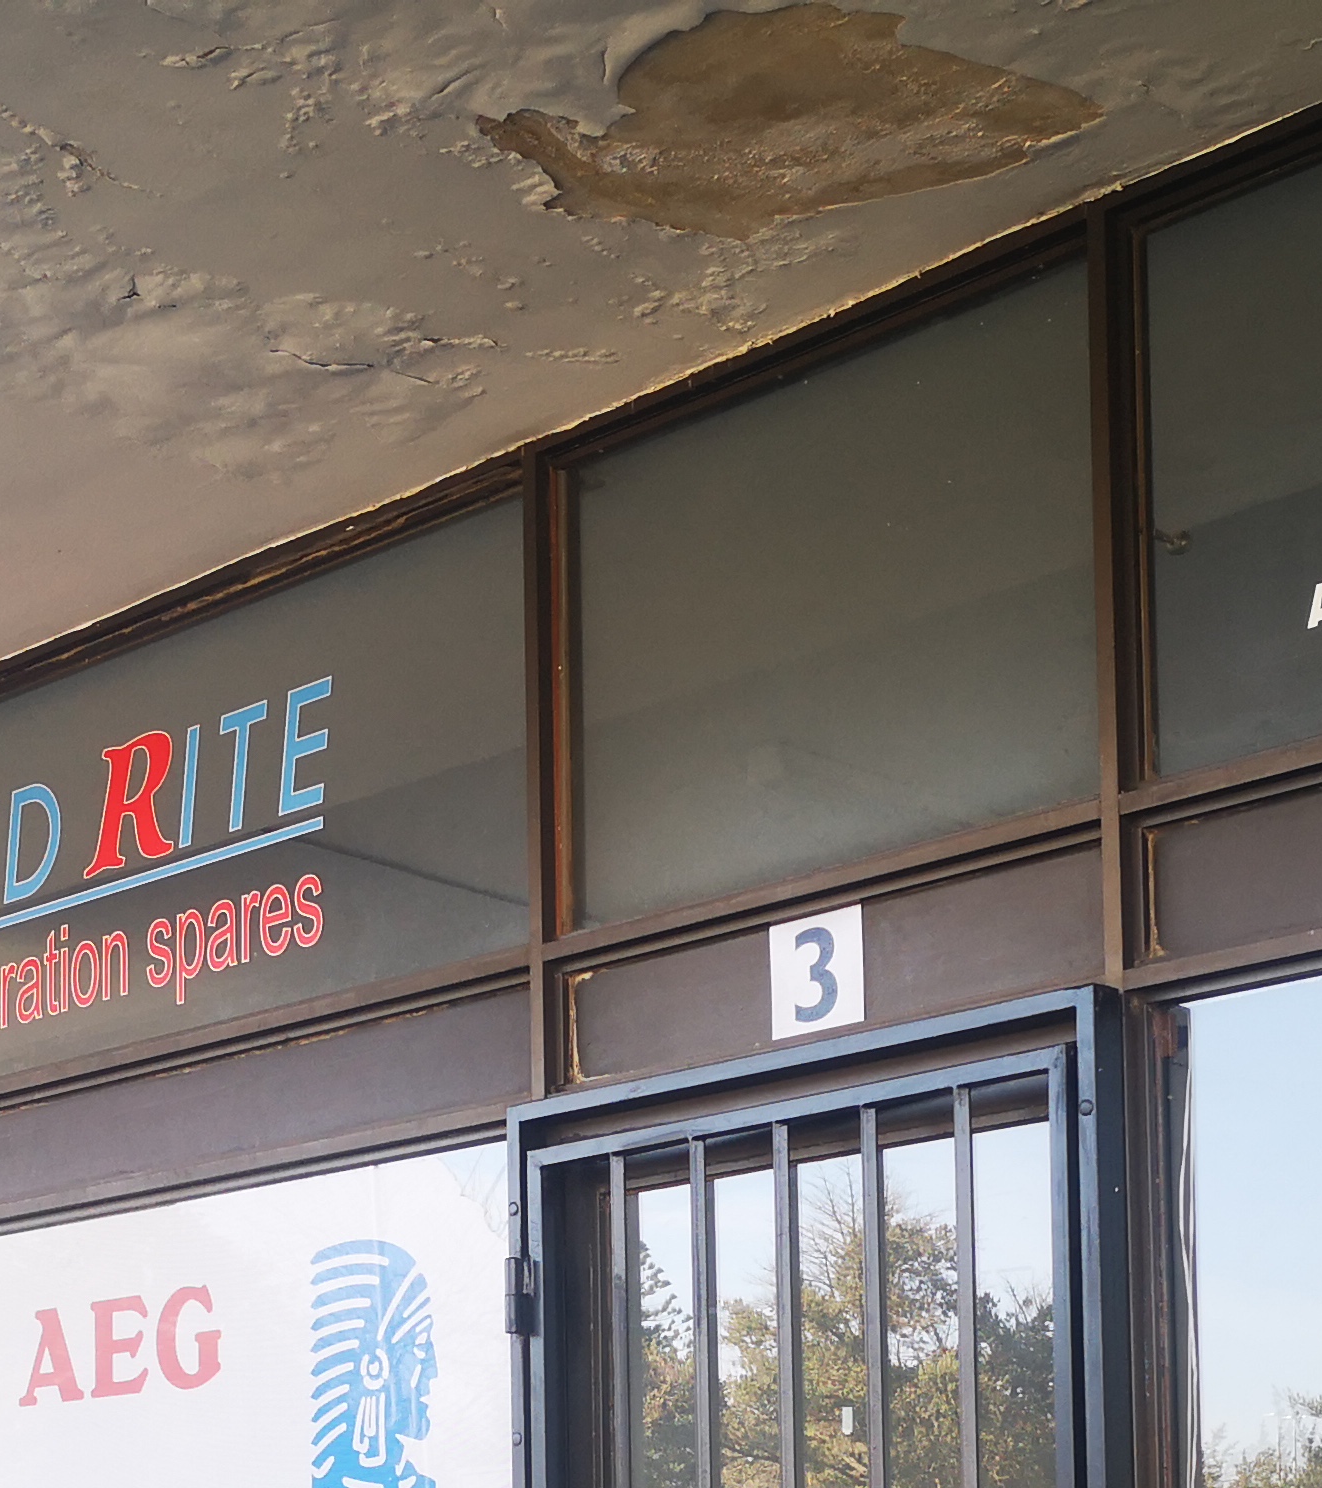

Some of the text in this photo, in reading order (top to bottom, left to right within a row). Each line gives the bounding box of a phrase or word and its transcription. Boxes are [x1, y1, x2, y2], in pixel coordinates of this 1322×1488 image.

[84, 676, 333, 879] RITE
[146, 874, 324, 1004] spares
[795, 927, 838, 1022] 3
[18, 1284, 222, 1407] AEG
